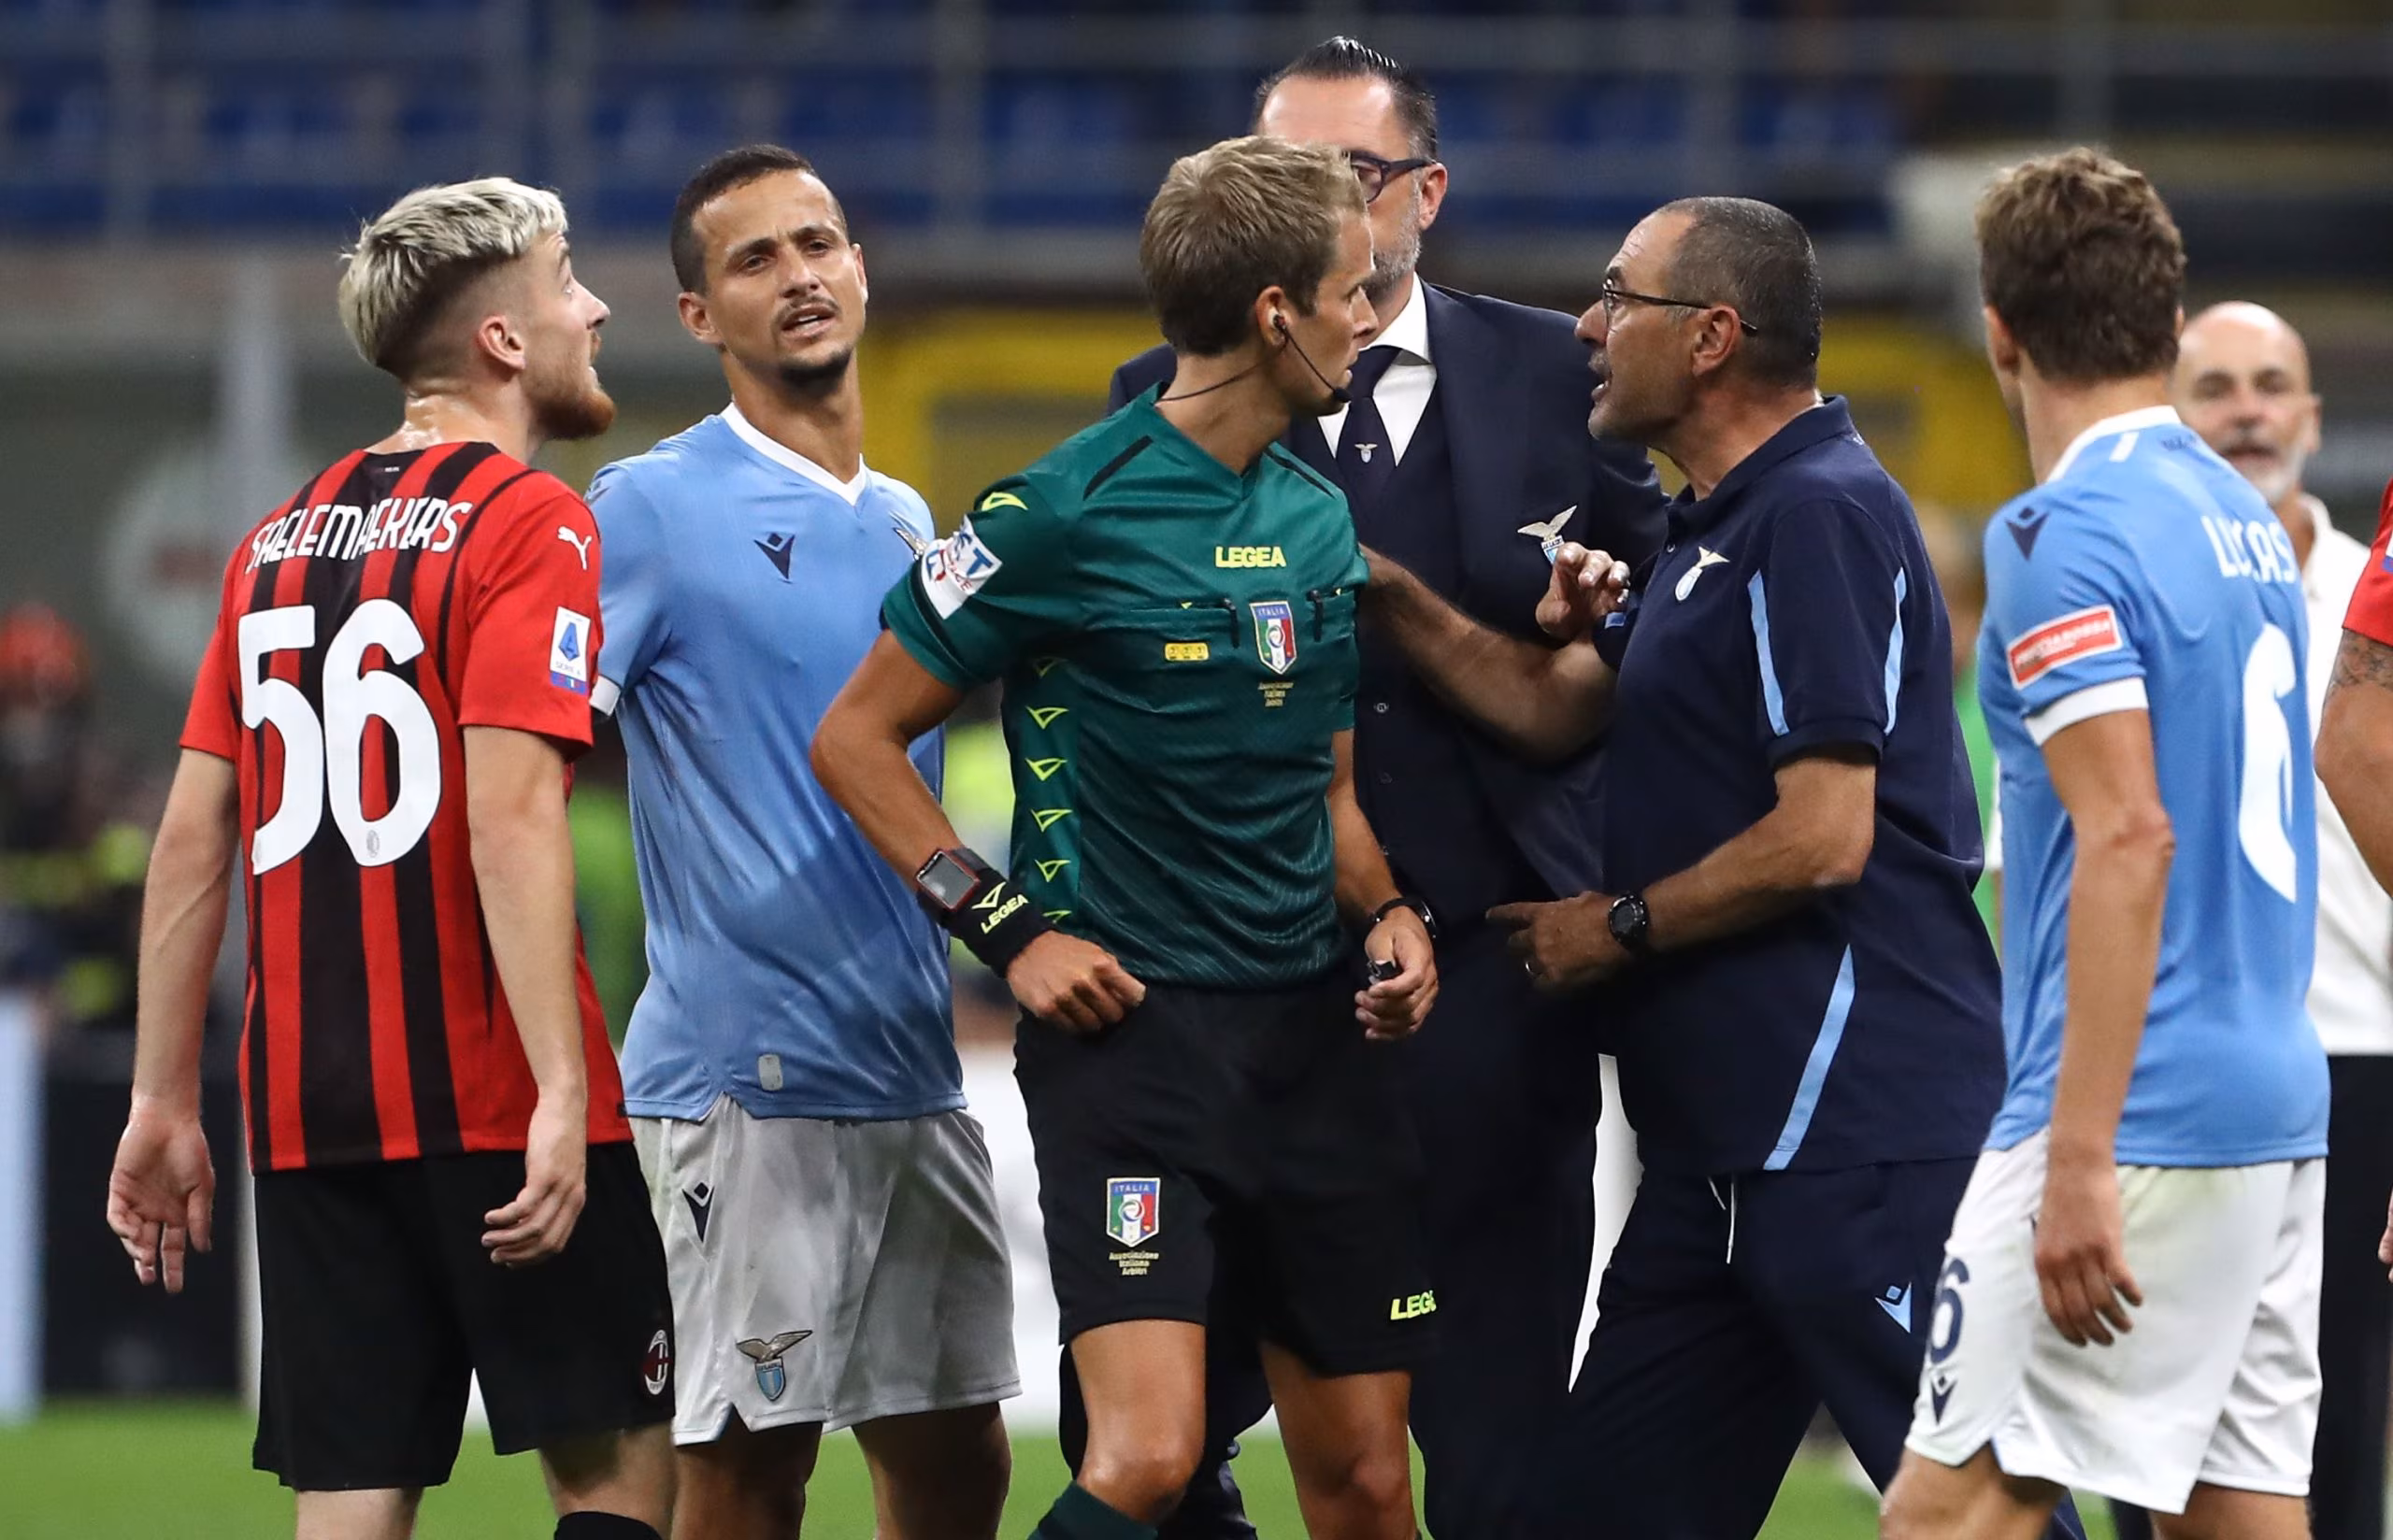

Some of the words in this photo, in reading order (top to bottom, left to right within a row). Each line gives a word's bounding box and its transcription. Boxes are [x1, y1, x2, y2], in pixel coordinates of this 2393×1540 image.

[1215, 546, 1286, 568] LEGEA
[1257, 607, 1285, 617] ITALIA
[237, 598, 440, 876] 56
[2239, 623, 2297, 904] 6
[981, 893, 1029, 934] LEGEA
[1114, 1184, 1150, 1192] ITALIA
[1929, 1258, 1970, 1364] 6
